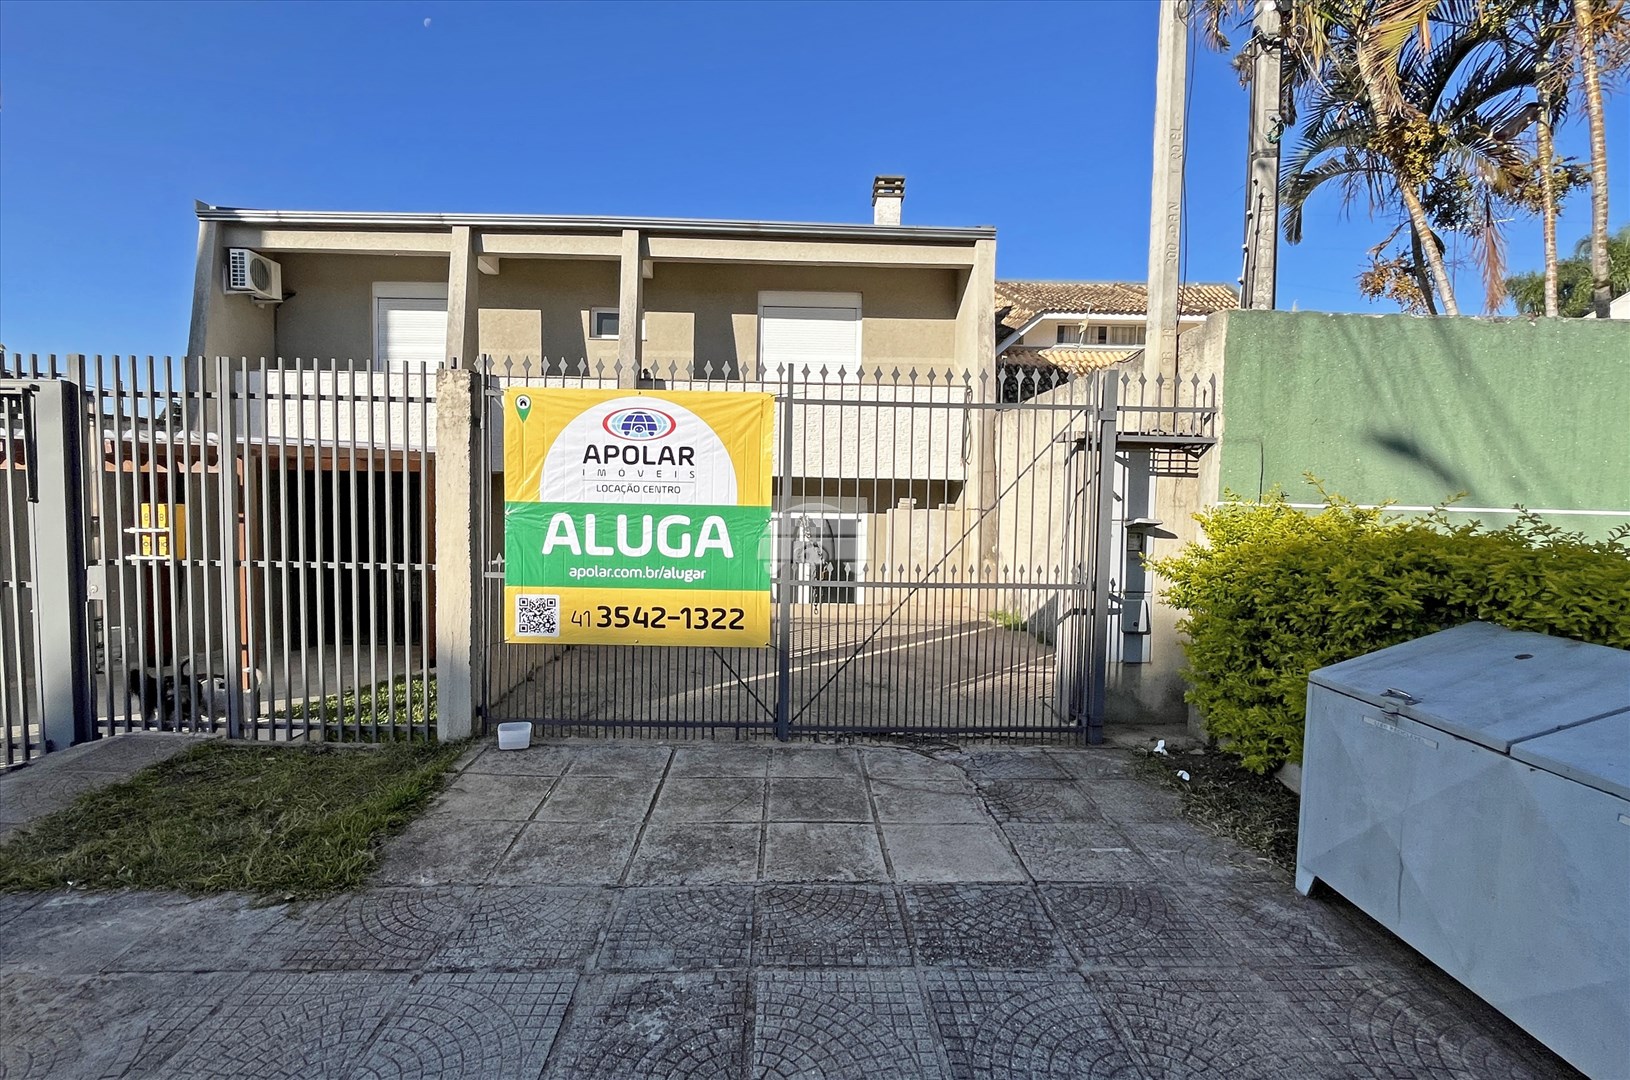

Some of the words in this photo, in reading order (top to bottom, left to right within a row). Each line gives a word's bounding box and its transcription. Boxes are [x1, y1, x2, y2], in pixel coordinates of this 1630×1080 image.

[582, 444, 695, 466] APOLAR
[582, 468, 695, 479] IMÓVEIS
[596, 483, 640, 495] LOCAÇÃO
[642, 485, 681, 494] CENTRO
[541, 512, 734, 559] ALUGA
[568, 565, 706, 583] apolar.com.br/alugar
[571, 610, 591, 627] 41
[596, 605, 745, 630] 3542-1322
